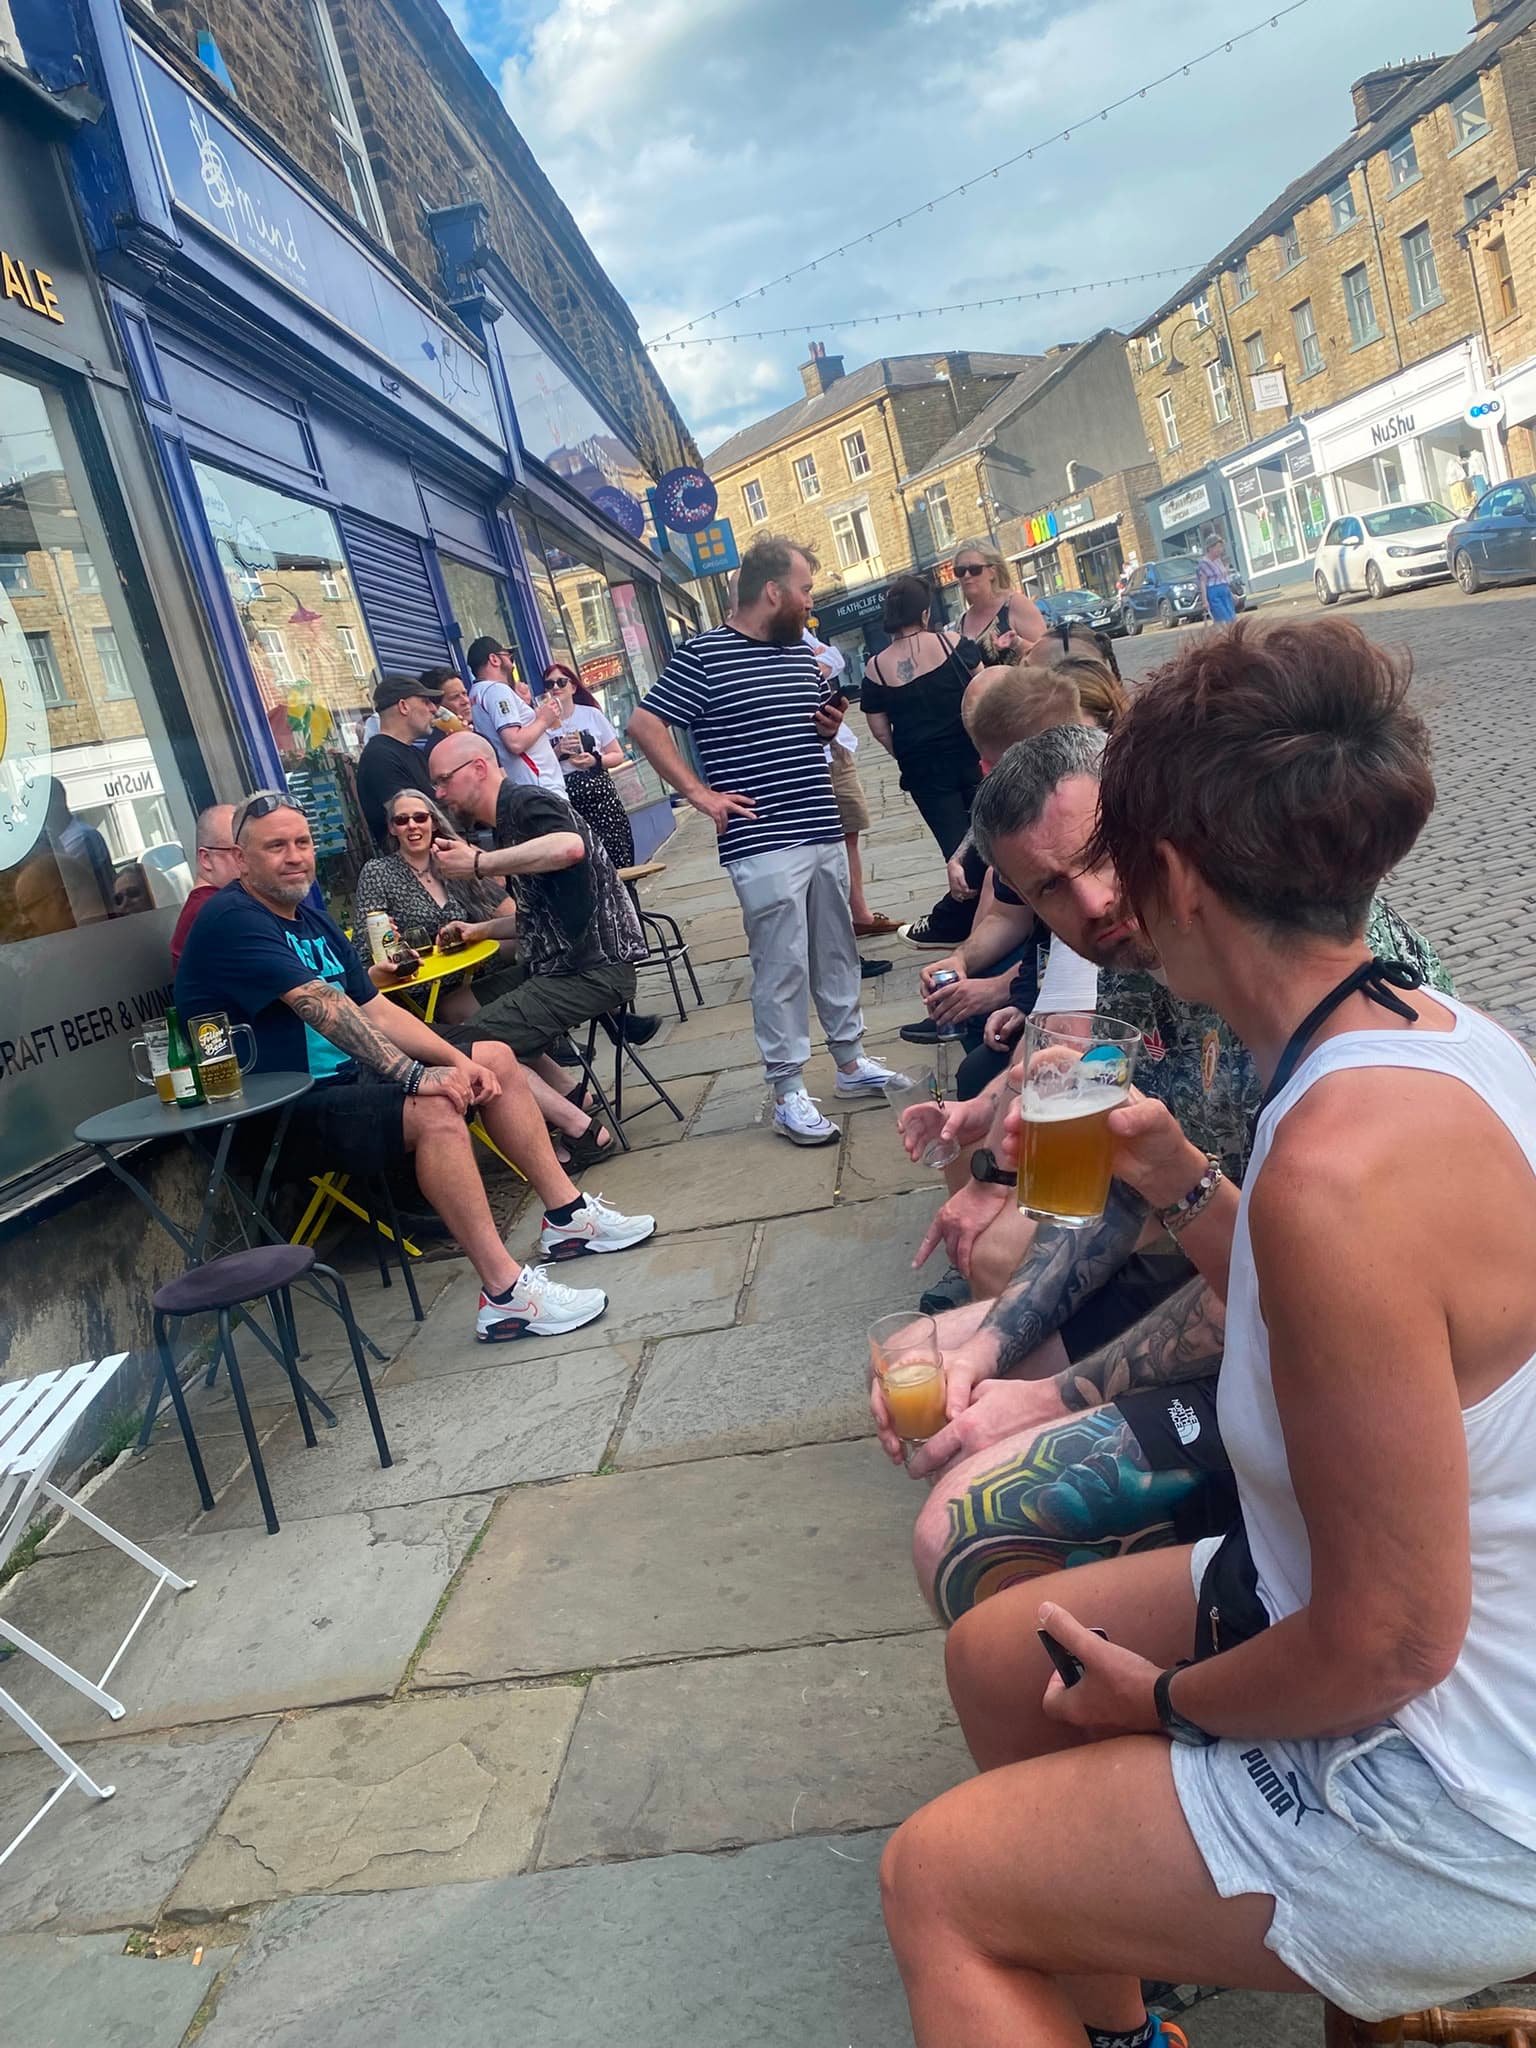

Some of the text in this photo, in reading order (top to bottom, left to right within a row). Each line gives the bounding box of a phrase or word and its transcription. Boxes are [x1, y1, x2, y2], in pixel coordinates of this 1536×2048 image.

[1, 250, 65, 325] ALE
[1470, 400, 1500, 418] TSB
[1371, 414, 1415, 446] NuShu
[836, 592, 887, 617] HEATHCLIFF &
[0, 1025, 59, 1080] RAFT
[60, 1006, 119, 1053] BEER
[117, 1000, 136, 1030] &
[1167, 1407, 1184, 1431] FACE
[1171, 1398, 1191, 1425] NORTH
[1185, 1405, 1198, 1425] THE
[1240, 1748, 1295, 1817] PUMA
